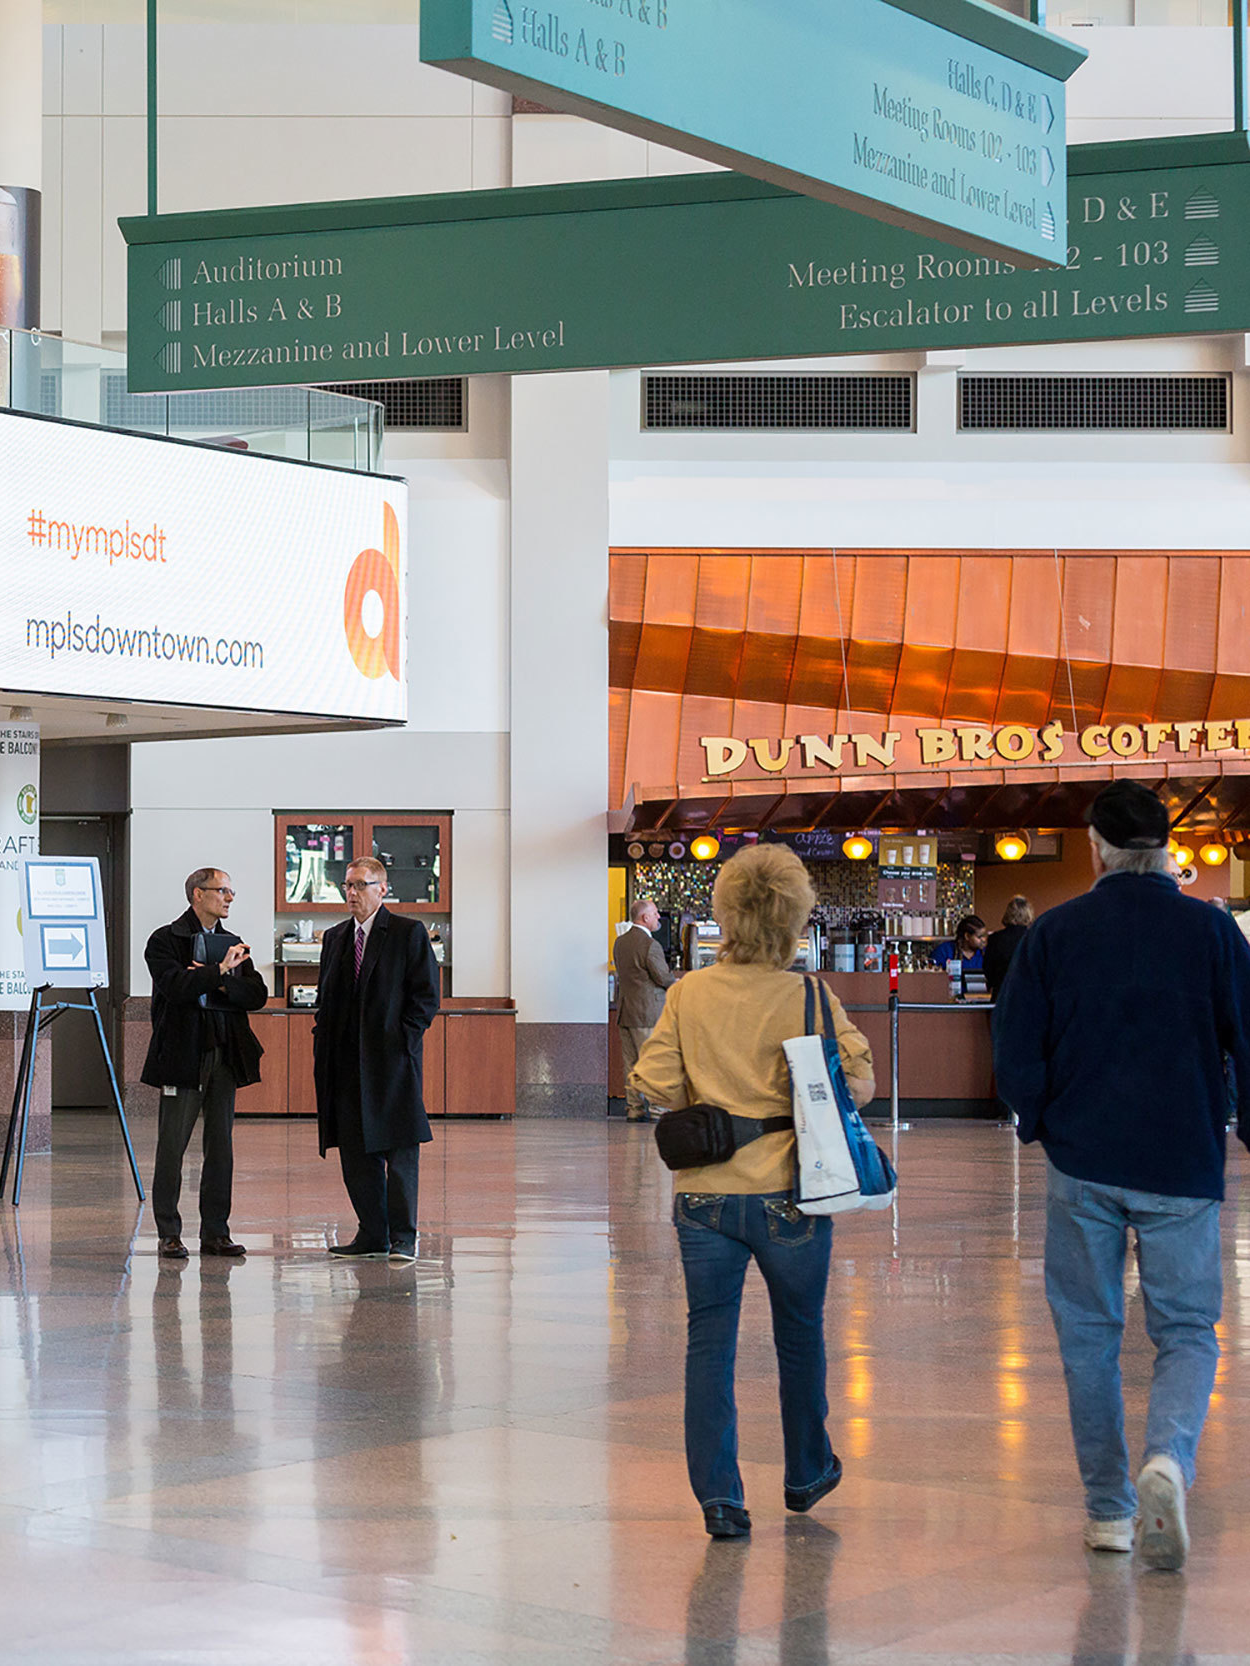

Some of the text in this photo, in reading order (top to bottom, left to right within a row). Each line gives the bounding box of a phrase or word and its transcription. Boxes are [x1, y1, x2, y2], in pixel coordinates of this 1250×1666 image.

[522, 7, 568, 57] Halls
[575, 28, 589, 66] A
[595, 38, 608, 73] &
[614, 41, 626, 77] B
[947, 58, 981, 100] Halls
[1001, 82, 1012, 113] D
[1015, 90, 1025, 119] &
[1027, 92, 1037, 124] E
[872, 82, 929, 143] Meeting
[932, 106, 976, 151] Rooms
[980, 130, 1003, 163] 102
[1014, 144, 1037, 176] 103
[853, 132, 1037, 230] Mezzanine and Lower Level
[1083, 191, 1169, 223] D & E
[191, 254, 343, 286] Auditorium
[787, 258, 906, 289] Meeting
[1116, 240, 1169, 267] 103
[192, 294, 342, 327] Halls A & B
[839, 284, 1168, 330] Escalator to all Levels
[192, 320, 565, 369] Mezzanine and Lower Level
[27, 509, 167, 566] #mymplsdt
[27, 610, 264, 668] mplsdowntown.com
[700, 731, 902, 777] DUNN
[917, 718, 1065, 763] BROS
